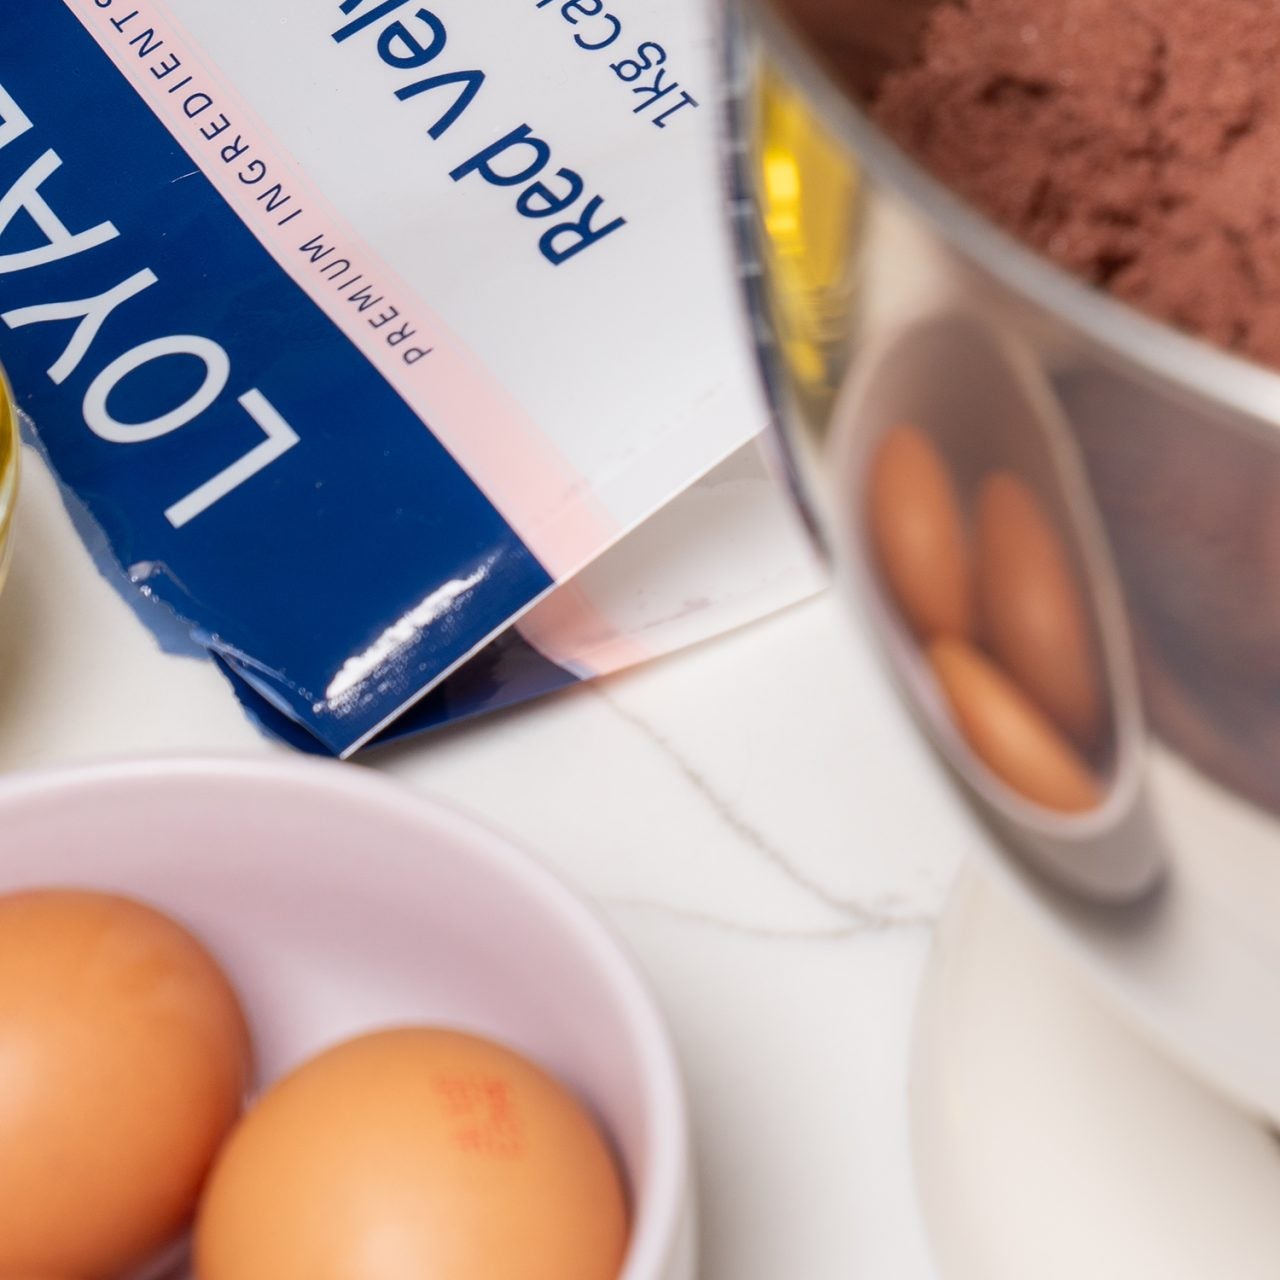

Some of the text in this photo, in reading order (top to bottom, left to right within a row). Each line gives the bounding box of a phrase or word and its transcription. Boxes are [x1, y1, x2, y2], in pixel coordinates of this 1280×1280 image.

[609, 40, 698, 129] 1kg
[448, 124, 627, 266] Red
[299, 234, 433, 366] PREMIUM
